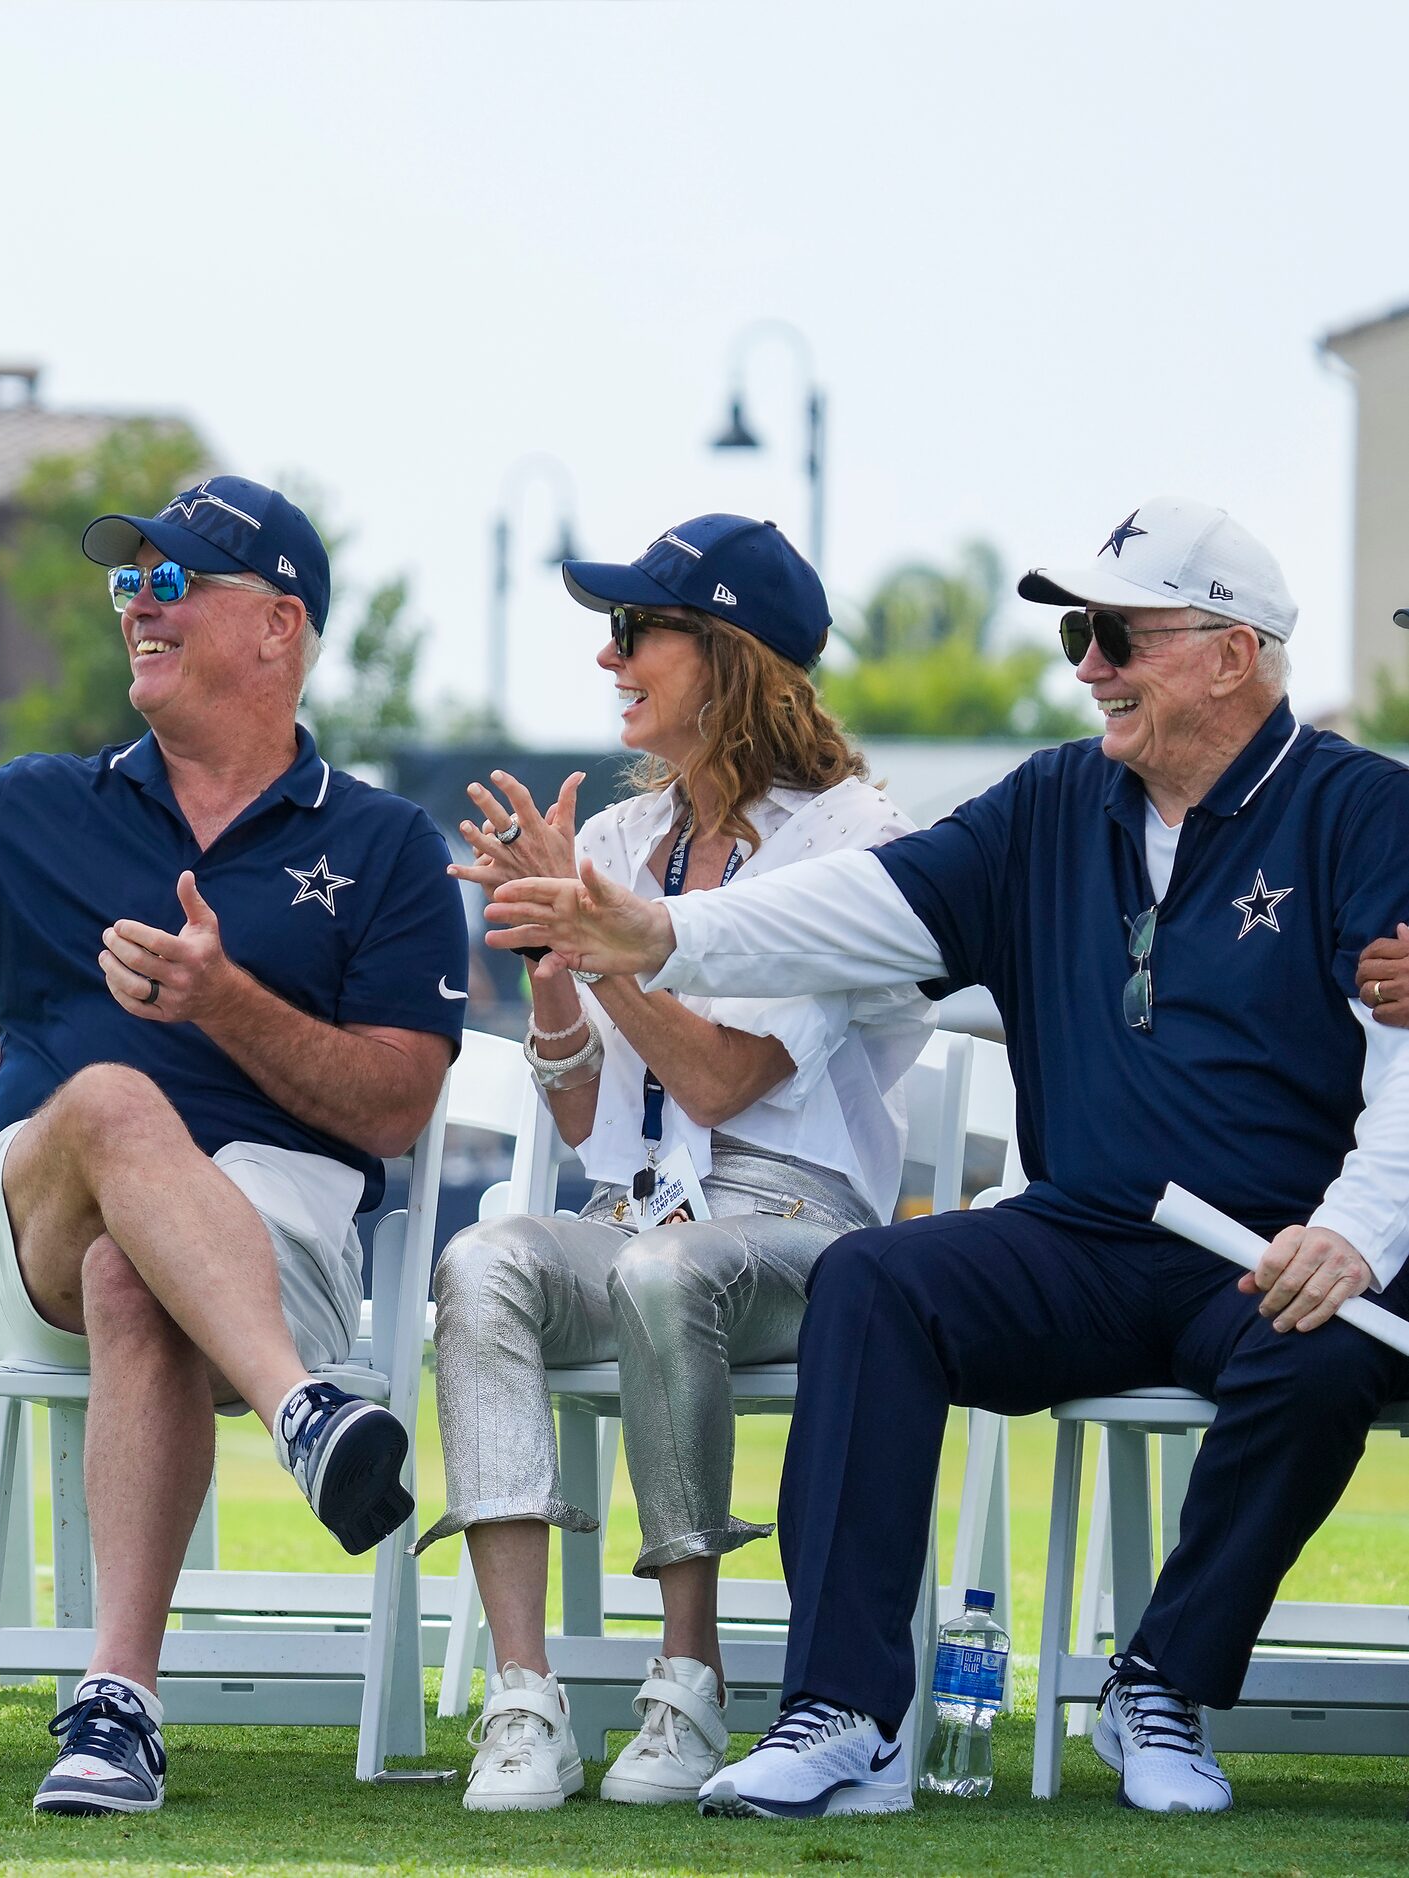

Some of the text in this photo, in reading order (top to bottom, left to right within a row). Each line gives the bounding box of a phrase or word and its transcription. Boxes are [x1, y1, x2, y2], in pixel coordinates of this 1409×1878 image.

[650, 1178, 682, 1209] TRAINING
[652, 1186, 685, 1216] CAMP 2023
[963, 1662, 980, 1674] BLUE
[964, 1652, 982, 1663] DEJA
